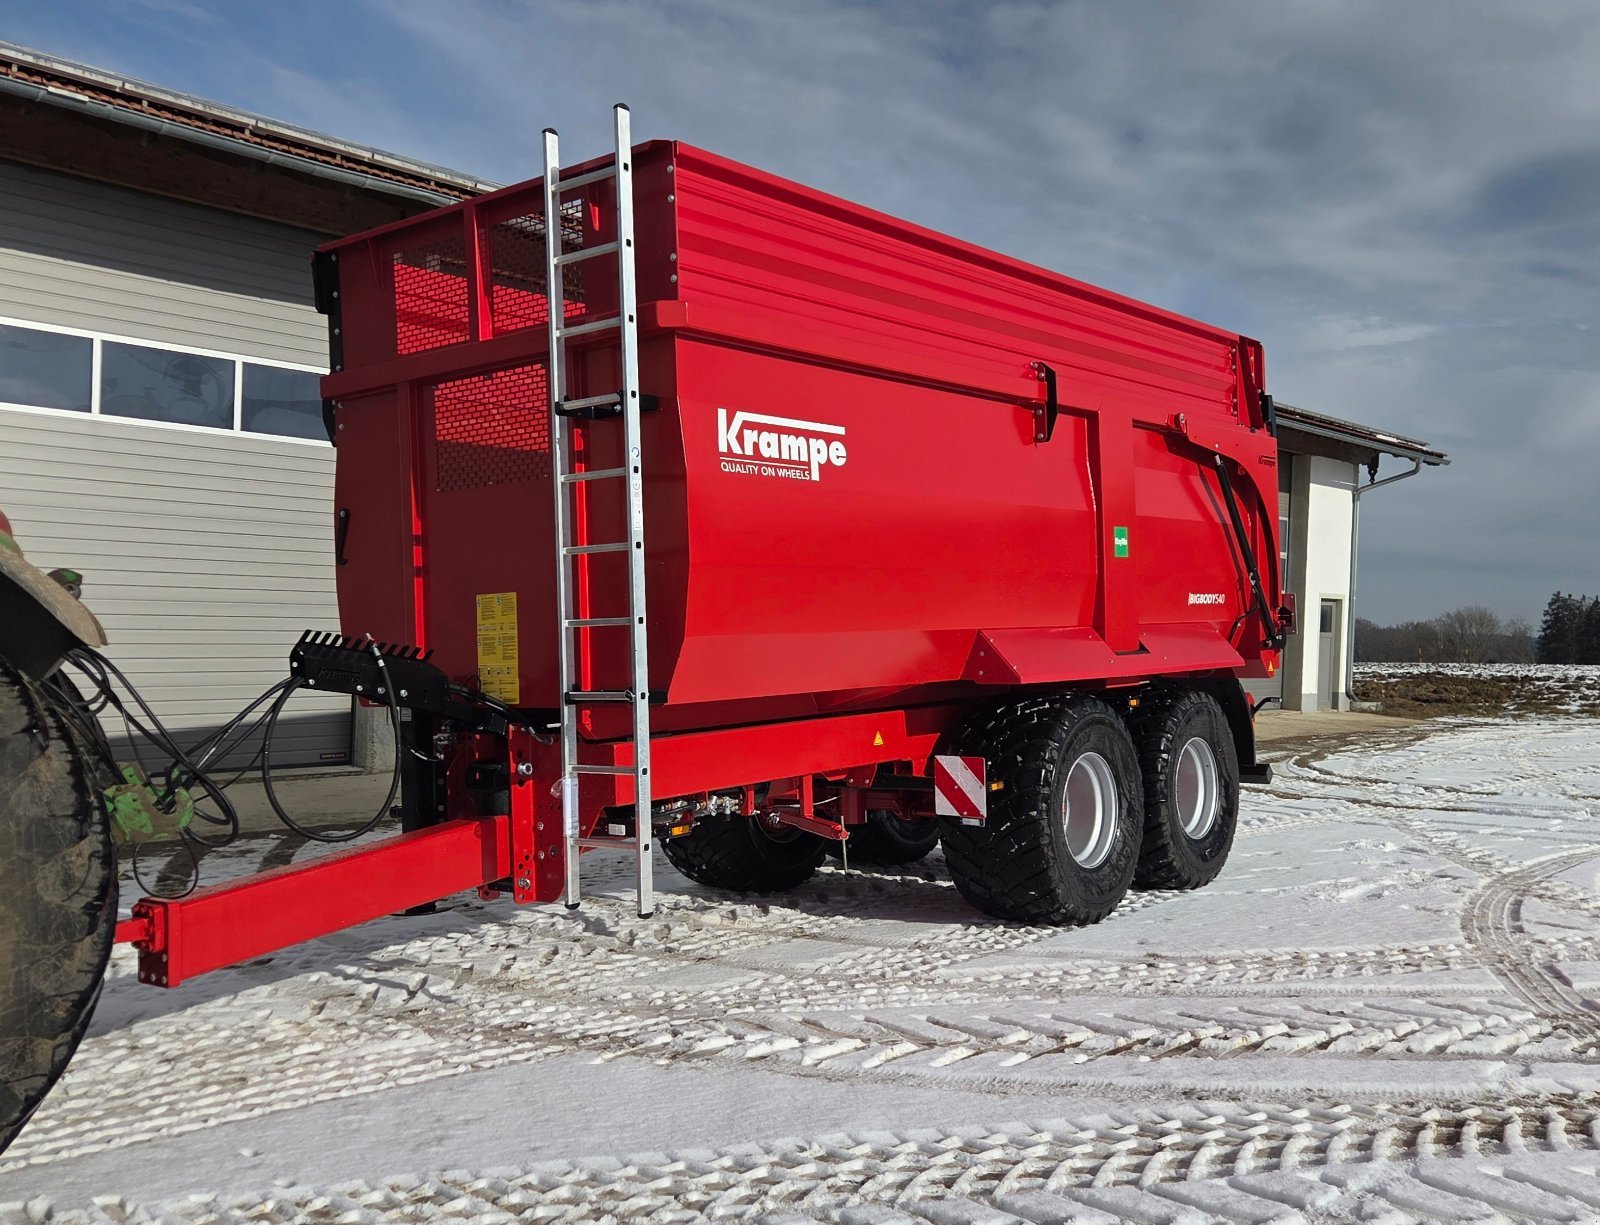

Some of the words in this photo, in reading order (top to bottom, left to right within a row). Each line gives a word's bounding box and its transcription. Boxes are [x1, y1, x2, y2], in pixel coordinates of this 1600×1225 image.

[717, 407, 847, 482] Krampe
[720, 461, 759, 476] QUALITY
[760, 466, 776, 477] ON
[777, 467, 811, 481] WHEELS
